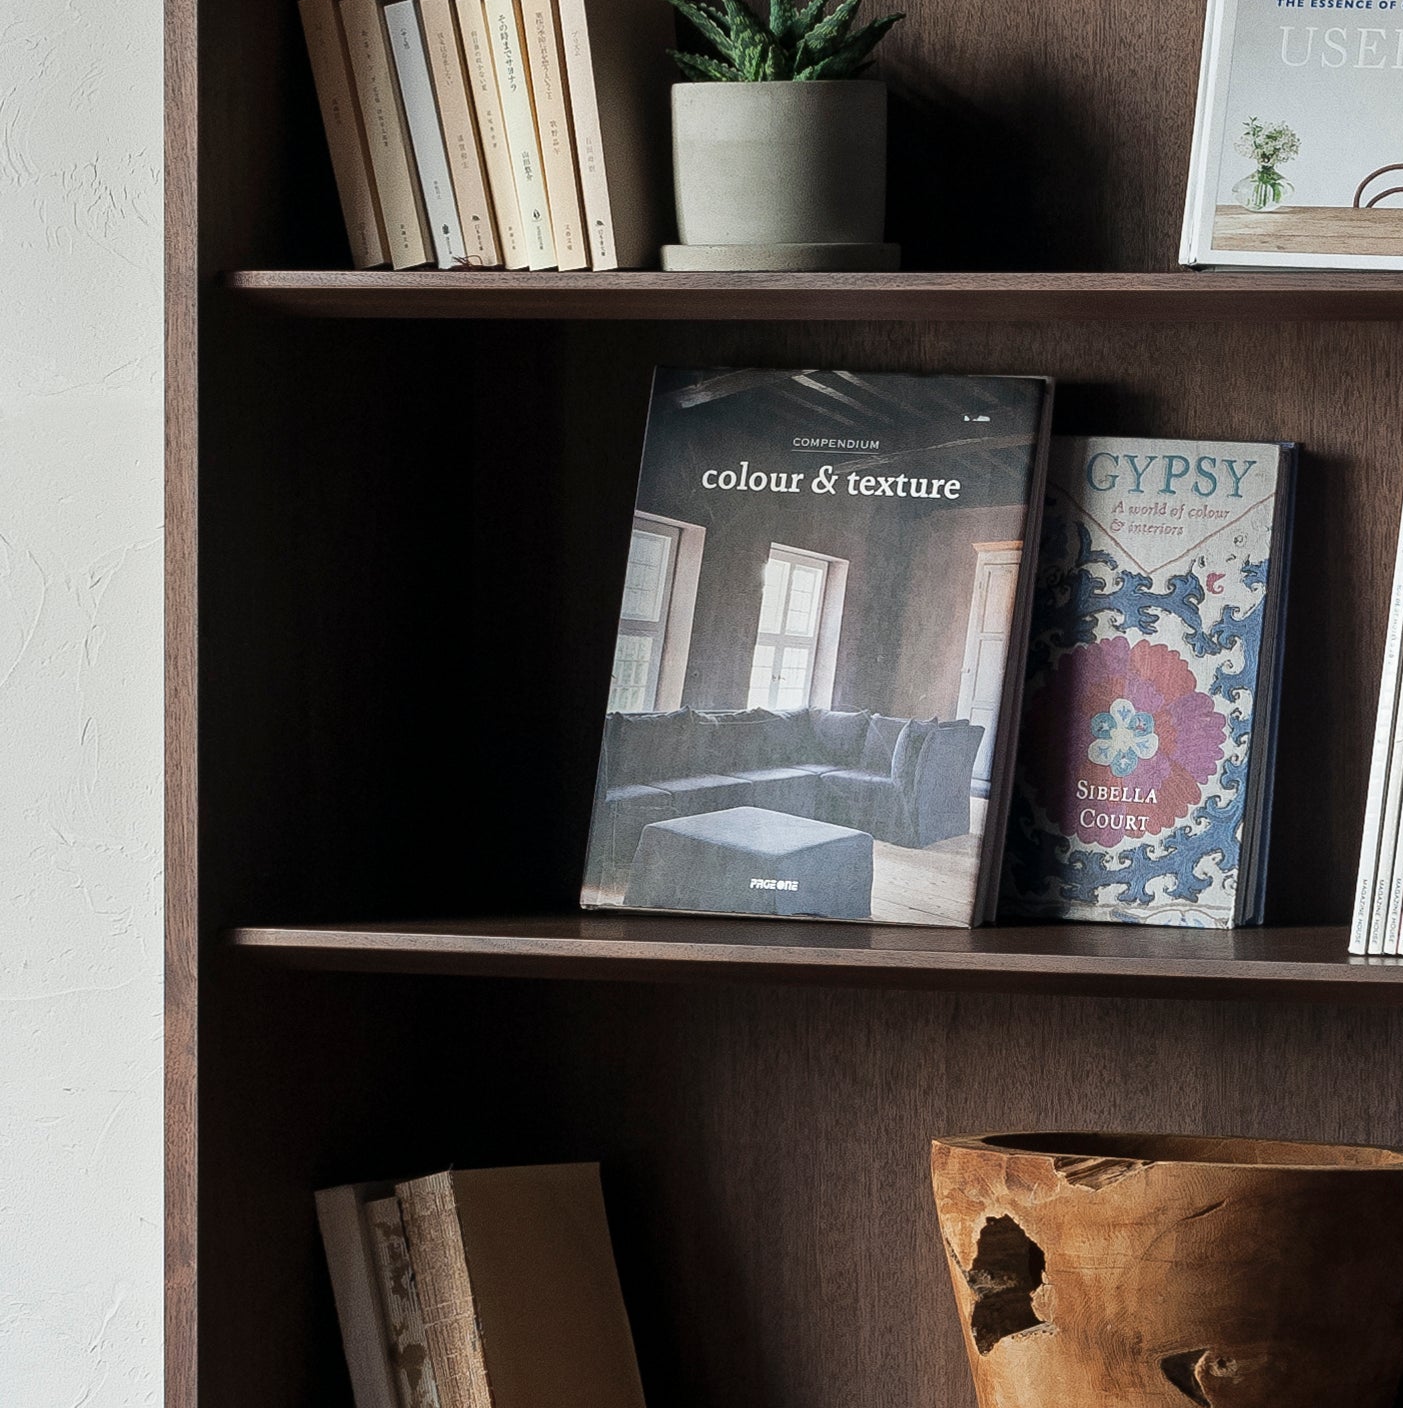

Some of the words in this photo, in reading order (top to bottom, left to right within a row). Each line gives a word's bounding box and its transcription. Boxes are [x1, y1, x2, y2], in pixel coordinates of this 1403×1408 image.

[1310, 0, 1373, 9] ESSENCE
[1379, 0, 1397, 10] OF
[498, 14, 517, 93] その時までサヨナラ
[792, 437, 880, 450] COMPENDIUM
[701, 461, 804, 493] colour
[811, 465, 837, 495] &
[847, 471, 961, 500] texture
[1086, 452, 1257, 498] GYPSY
[1111, 501, 1124, 514] A
[1129, 503, 1166, 515] world
[1170, 504, 1186, 520] of
[1188, 505, 1230, 519] colour
[1110, 519, 1125, 533] &
[1128, 521, 1184, 535] interiors
[1076, 779, 1158, 804] SIBELLA
[1080, 808, 1149, 831] COURT
[1359, 879, 1368, 916] MAGAZINE
[1375, 879, 1384, 916] MAGAZINE
[1392, 878, 1401, 915] MAGAZINE
[1355, 918, 1363, 944] HOUSE
[1372, 919, 1380, 944] HOUSE
[1389, 917, 1397, 943] HOUSE
